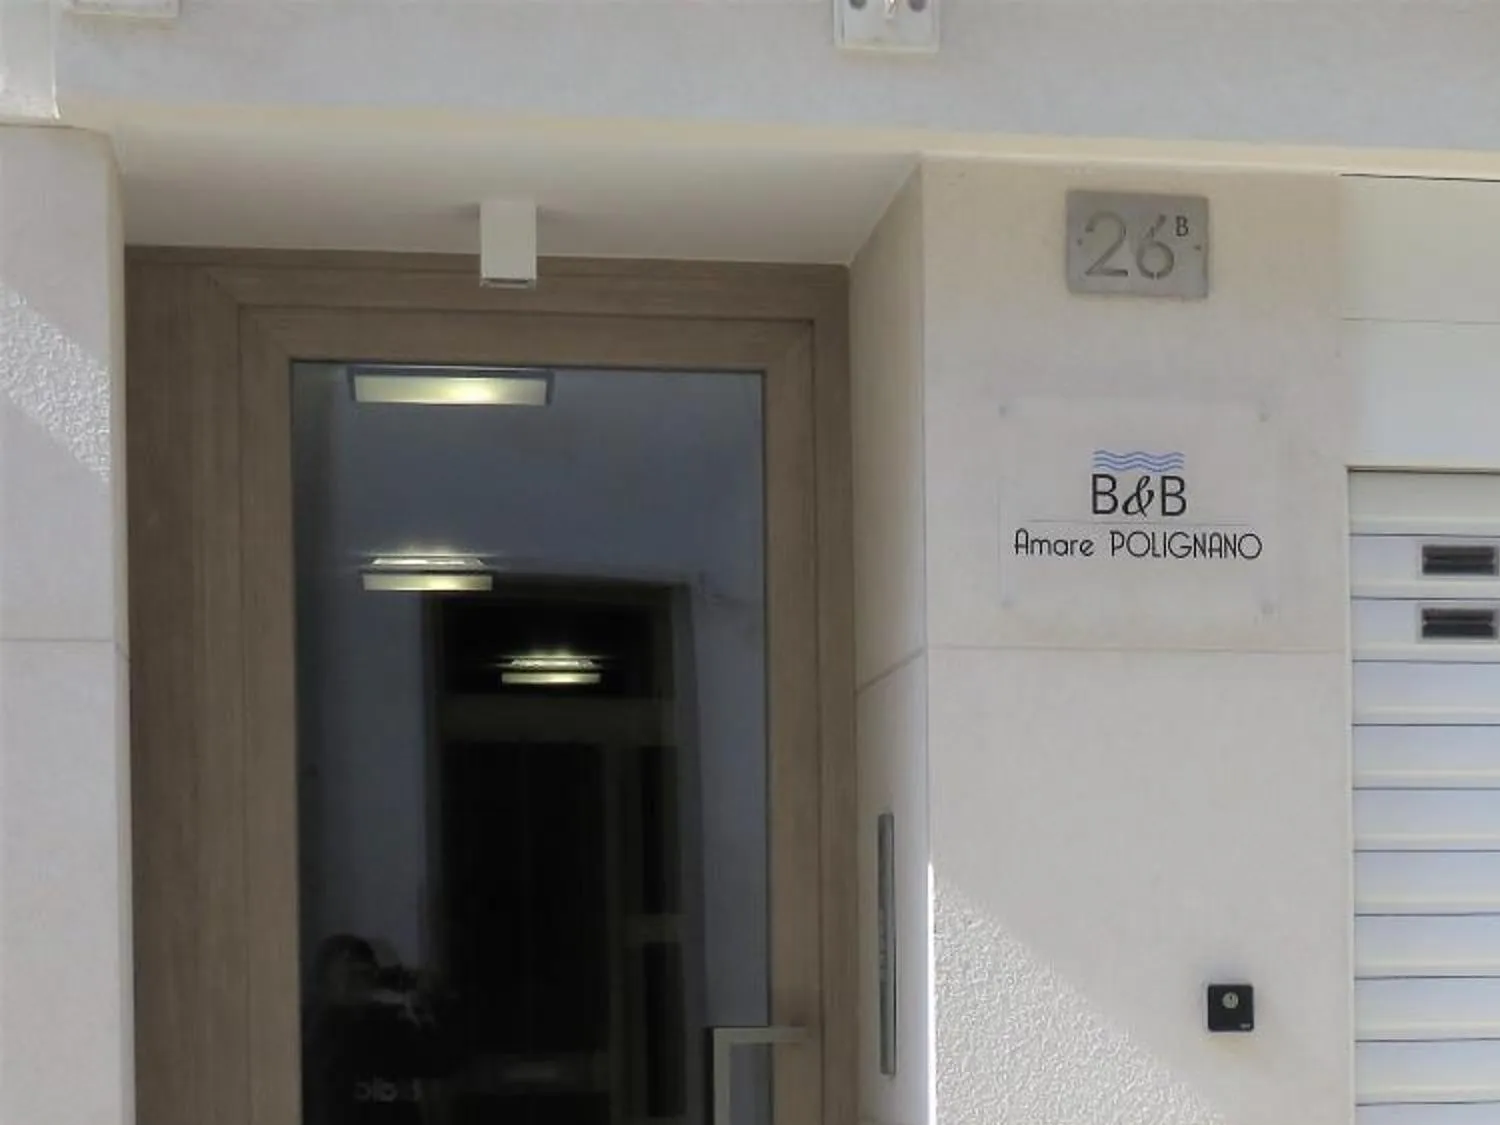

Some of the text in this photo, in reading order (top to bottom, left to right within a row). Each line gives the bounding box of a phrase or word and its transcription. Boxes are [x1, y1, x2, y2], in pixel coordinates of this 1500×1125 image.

[1091, 473, 1187, 517] B&B
[1014, 528, 1263, 560] Amare POLIGNANO
